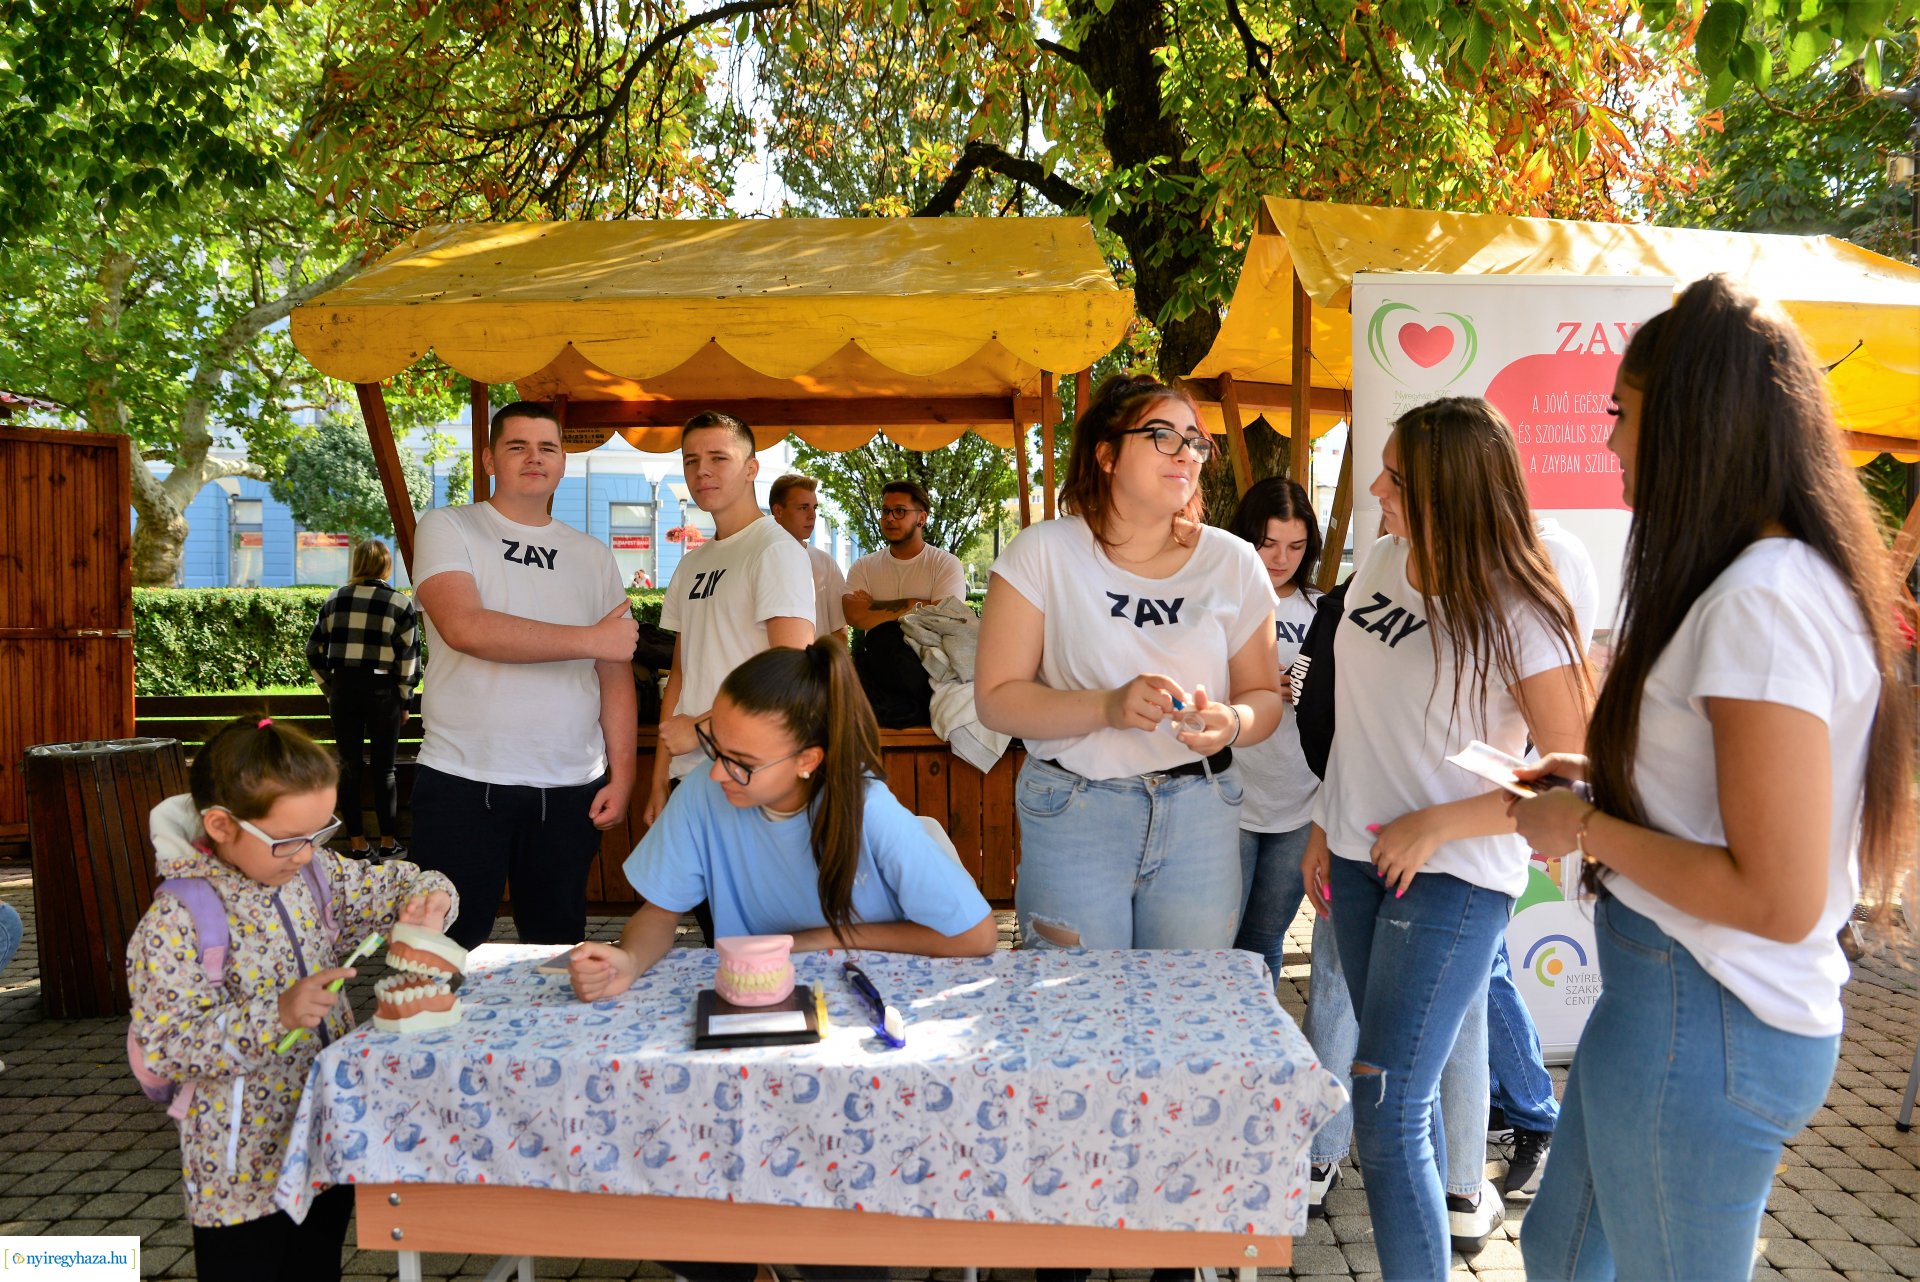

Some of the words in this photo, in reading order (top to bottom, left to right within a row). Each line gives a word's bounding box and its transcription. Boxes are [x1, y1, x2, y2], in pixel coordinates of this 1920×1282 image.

[1532, 394, 1539, 414] A
[1543, 391, 1569, 414] JÖVŐ
[1574, 391, 1618, 414] EGÉSZS
[1518, 421, 1531, 443] ÉS
[1535, 421, 1586, 443] SZOCIÁLIS
[1530, 454, 1537, 473] A
[1542, 454, 1581, 473] ZAYBAN
[501, 538, 558, 570] ZAY
[1105, 590, 1185, 628] ZAY
[1348, 592, 1428, 649] ZAY
[1275, 620, 1306, 644] AY
[1565, 984, 1604, 995] SZAKK
